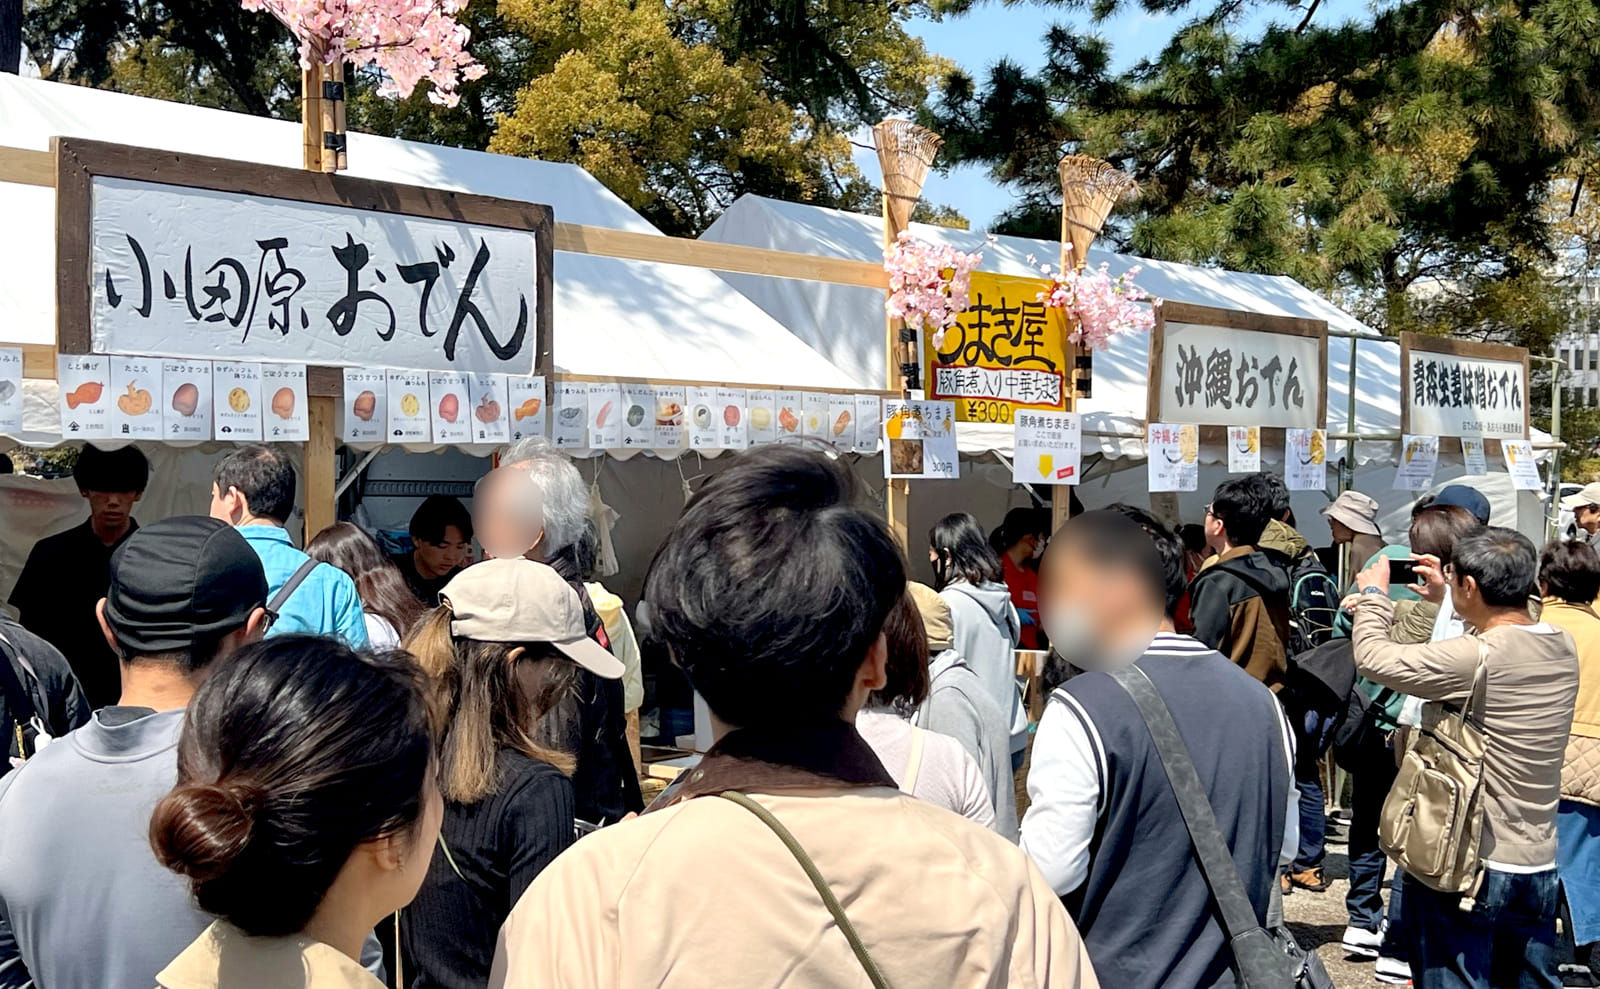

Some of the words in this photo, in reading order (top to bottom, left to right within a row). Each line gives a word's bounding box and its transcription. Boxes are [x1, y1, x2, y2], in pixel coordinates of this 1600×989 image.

[106, 232, 528, 361] 小田原おでん
[125, 364, 149, 373] たこ天
[1175, 343, 1304, 410] 沖縄おでん
[1413, 358, 1522, 411] 青森生姜味噌おでん
[886, 404, 952, 420] 豚角煮ちまき
[967, 400, 1010, 422] ¥300
[932, 462, 953, 473] 300円
